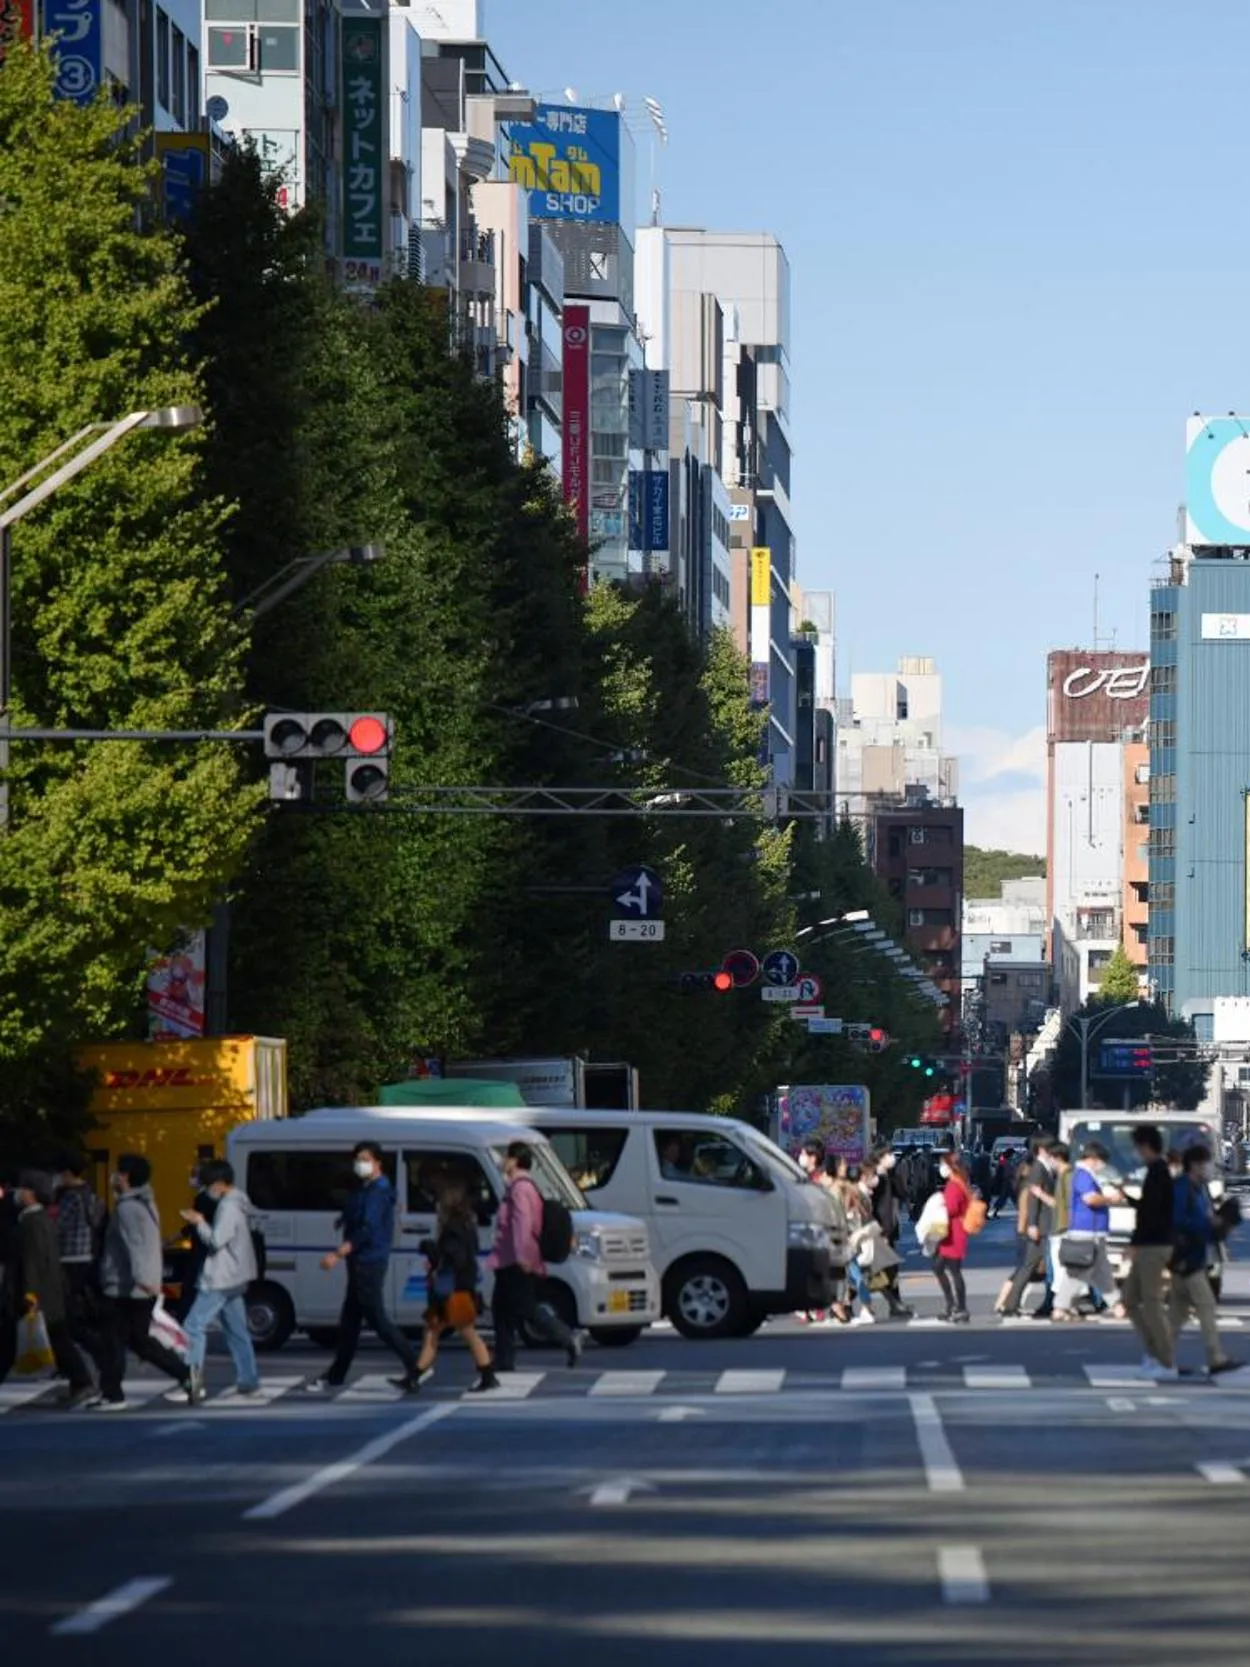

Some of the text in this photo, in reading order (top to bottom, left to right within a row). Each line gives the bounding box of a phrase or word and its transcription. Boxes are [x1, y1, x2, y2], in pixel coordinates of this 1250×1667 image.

[348, 76, 378, 243] ネットカフェ
[546, 193, 598, 214] SHOP
